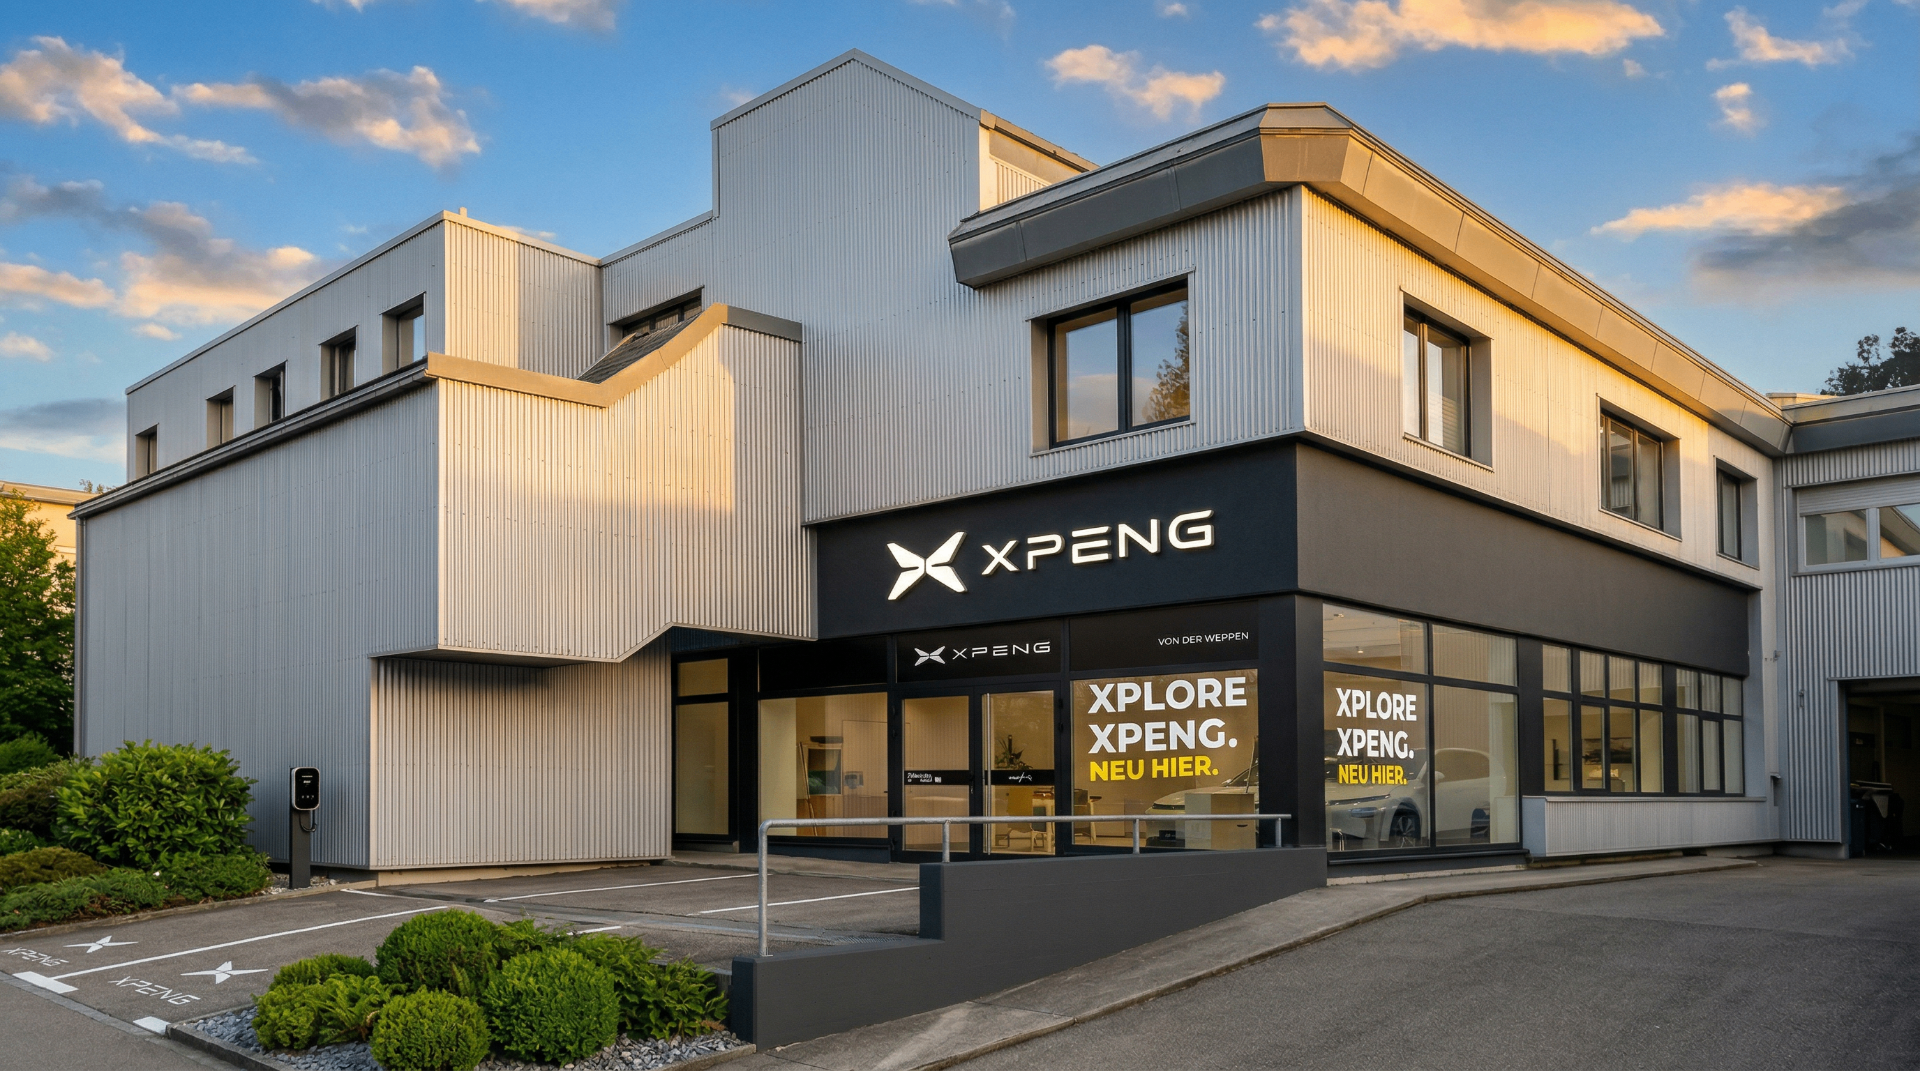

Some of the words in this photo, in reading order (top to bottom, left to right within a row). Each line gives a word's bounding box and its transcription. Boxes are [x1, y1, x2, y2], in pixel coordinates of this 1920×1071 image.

[981, 508, 1215, 576] XPENG
[952, 641, 1051, 661] XPENG
[1157, 637, 1180, 647] VON
[1182, 635, 1203, 645] DER
[1204, 631, 1250, 643] WEPPEN
[1087, 676, 1248, 714] XPLORE
[1336, 687, 1417, 722] XPLORE
[1088, 718, 1238, 754] XPENG.
[1336, 727, 1415, 760] XPENG.
[1089, 759, 1145, 782] NEU
[1151, 755, 1219, 779] HIER.
[1338, 763, 1369, 785] NEU
[1371, 764, 1408, 785] HIER.
[108, 976, 201, 1006] XPENG
